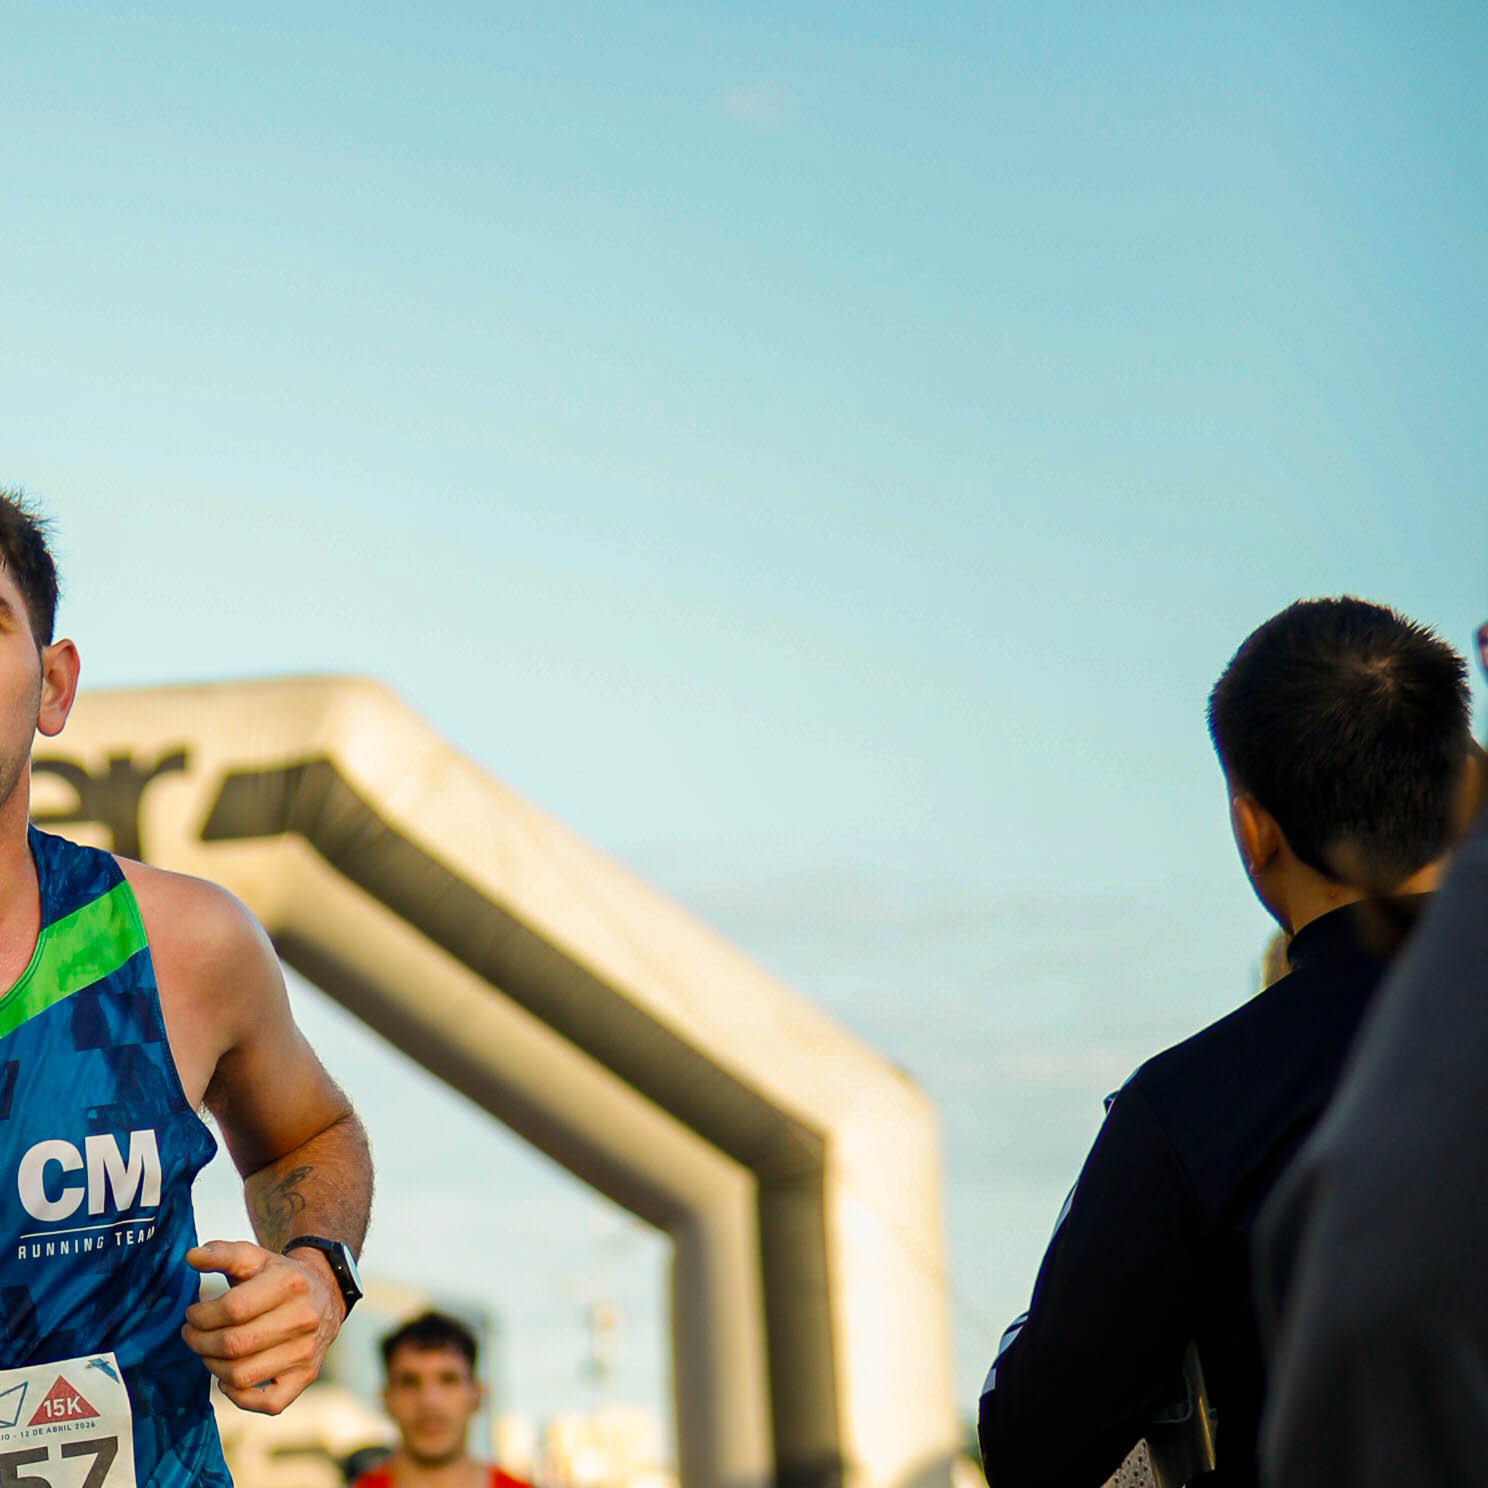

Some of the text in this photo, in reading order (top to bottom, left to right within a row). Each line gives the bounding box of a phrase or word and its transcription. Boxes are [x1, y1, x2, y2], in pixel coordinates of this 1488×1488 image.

[18, 1129, 161, 1222] CM
[18, 1226, 155, 1260] RUNNING TEAM
[43, 1395, 82, 1418] 15K
[20, 1430, 29, 1439] 12
[33, 1427, 43, 1436] DE
[46, 1424, 72, 1434] ABRIL
[75, 1421, 96, 1431] 2026
